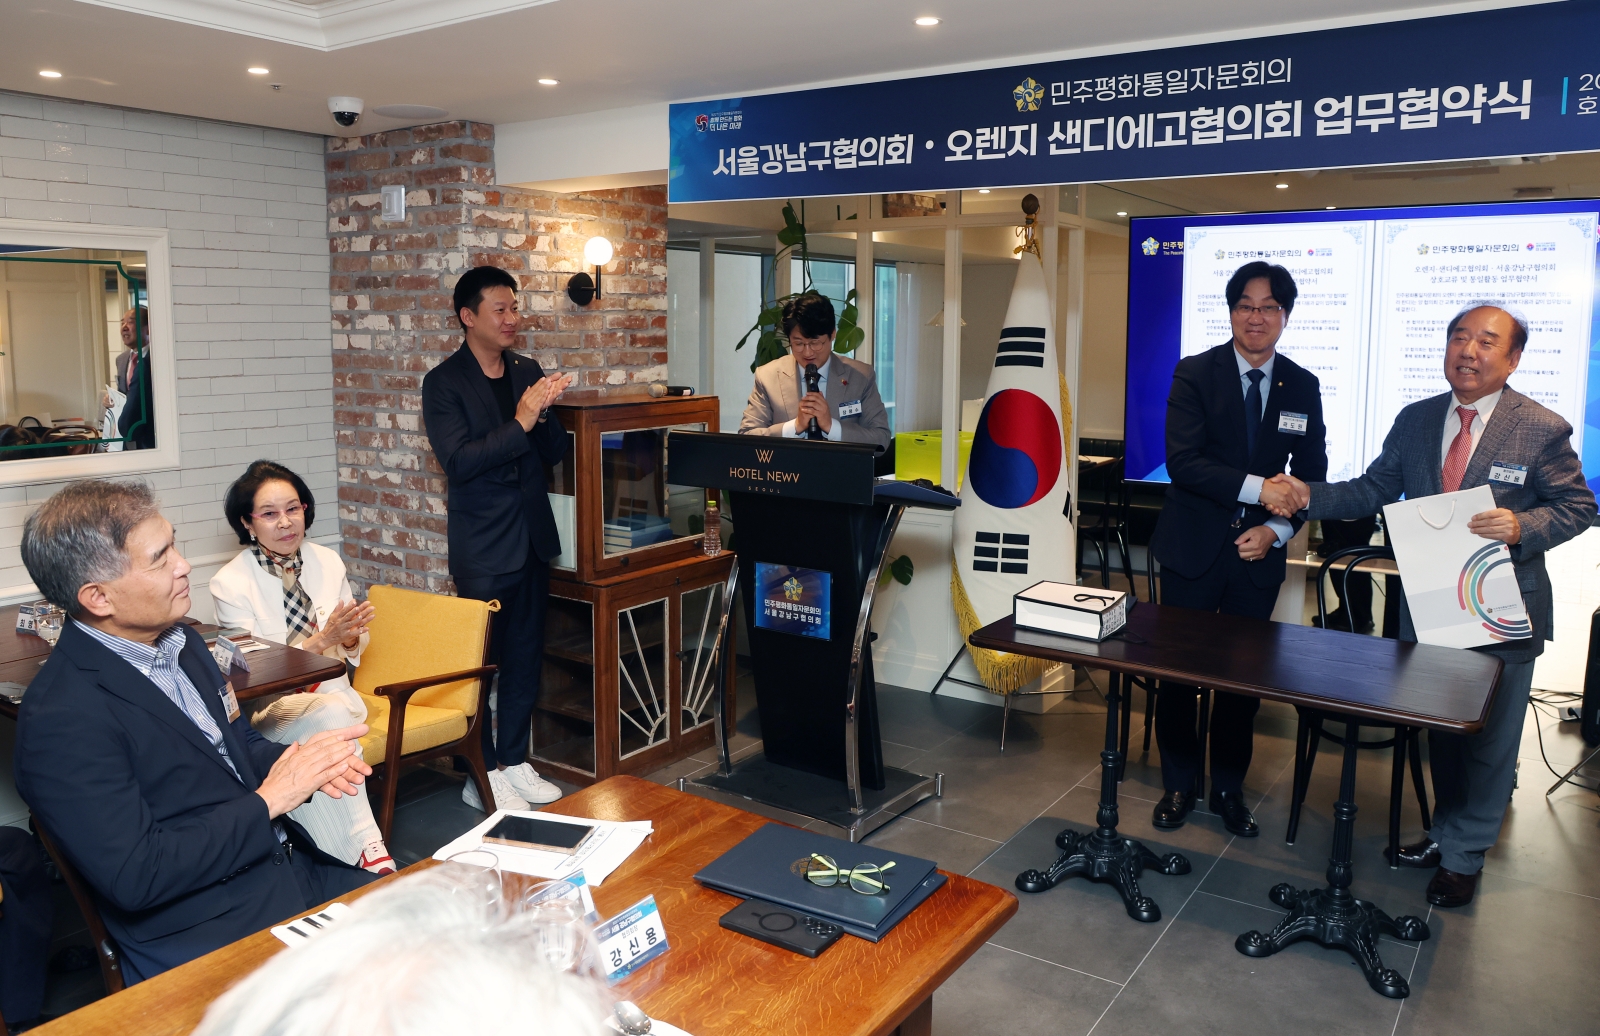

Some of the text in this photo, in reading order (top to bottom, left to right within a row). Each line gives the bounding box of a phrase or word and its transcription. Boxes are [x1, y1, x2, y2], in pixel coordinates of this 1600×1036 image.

[1050, 57, 1293, 106] 민주평화통일자문회의
[1577, 96, 1598, 115] 호
[712, 133, 915, 177] 서울강남구협의회
[944, 124, 1037, 163] 오렌지
[1047, 99, 1303, 157] 샌디에고협의회
[1313, 79, 1533, 137] 업무협약식
[1228, 250, 1302, 258] 민주평화통일자문회의
[1432, 244, 1519, 254] 민주평화통일자문회의
[1496, 263, 1556, 272] 서울강남구협의회
[1500, 275, 1538, 283] 업무협약서
[729, 467, 764, 481] HOTEL
[748, 486, 780, 494] SEOUL
[764, 599, 822, 616] 민주평화통일자문회의
